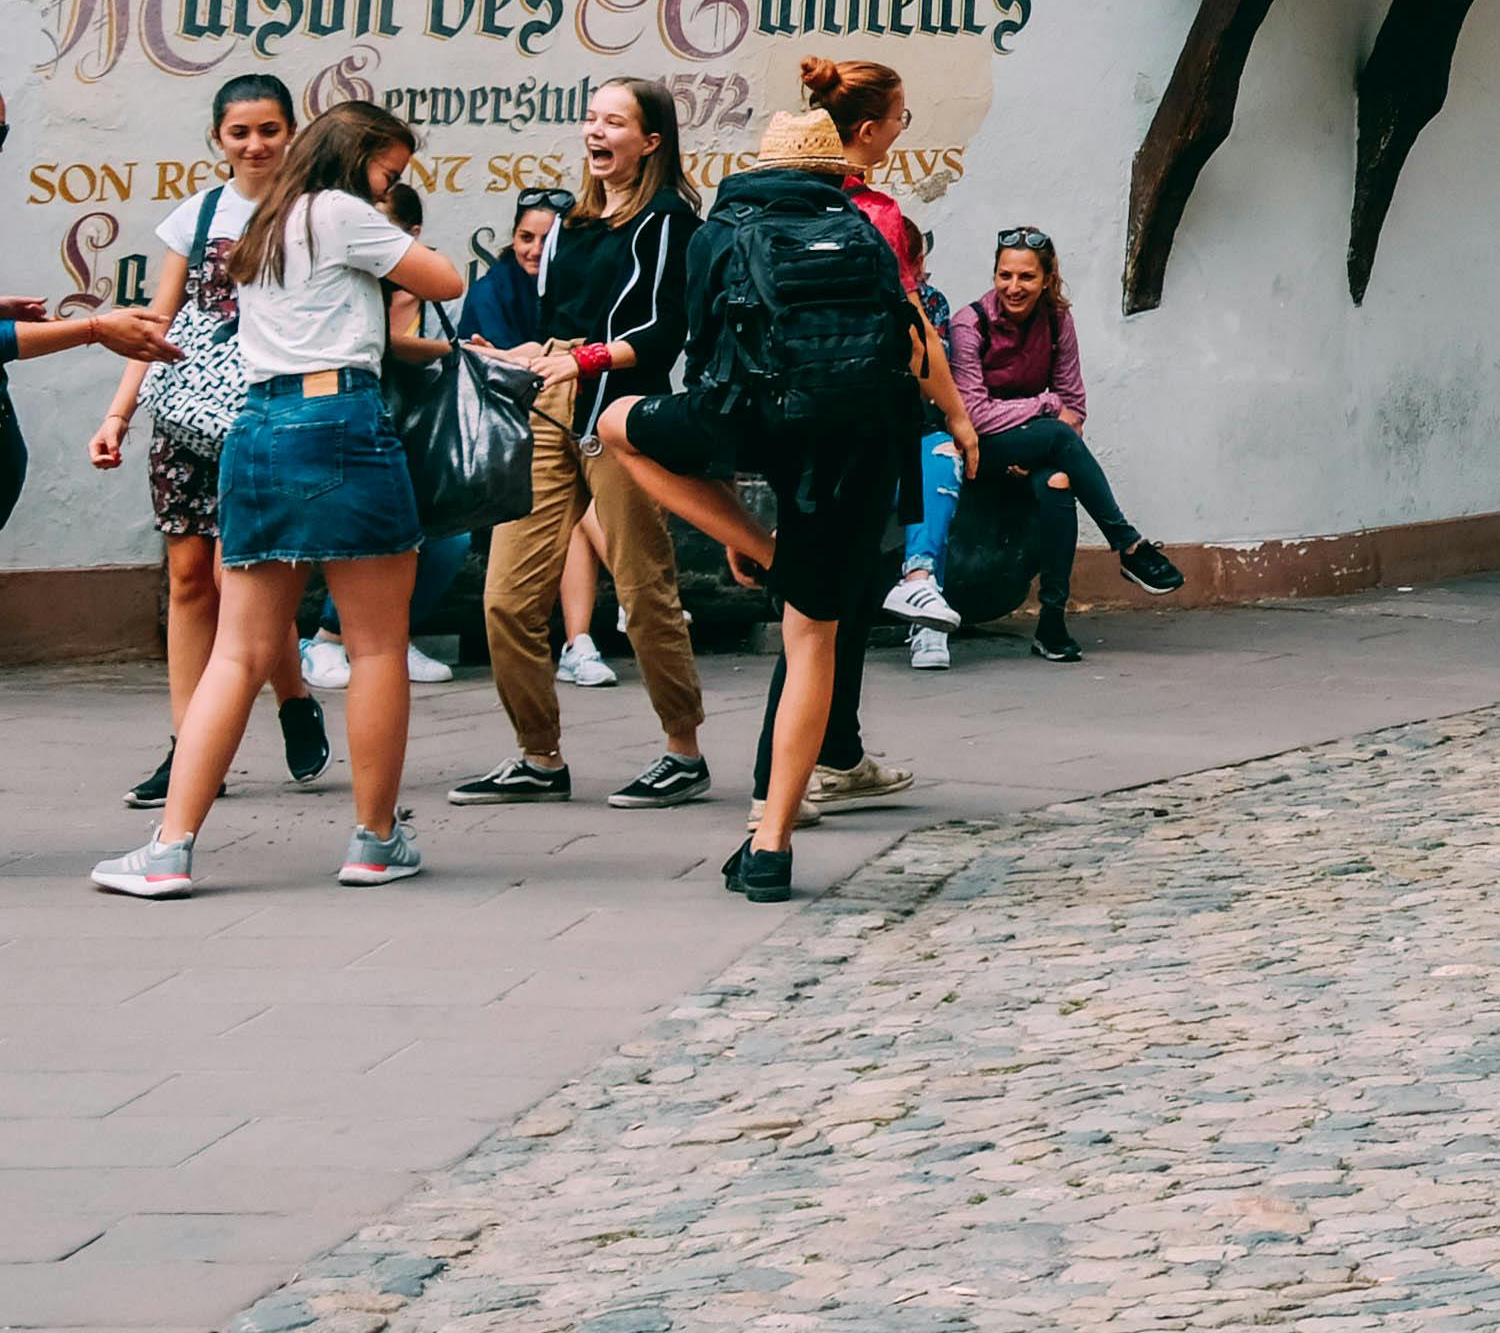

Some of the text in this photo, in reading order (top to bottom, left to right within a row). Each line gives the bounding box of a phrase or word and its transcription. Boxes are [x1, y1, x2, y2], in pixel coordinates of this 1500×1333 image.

[657, 72, 753, 130] 572
[26, 164, 138, 204] SON
[486, 153, 565, 193] SES
